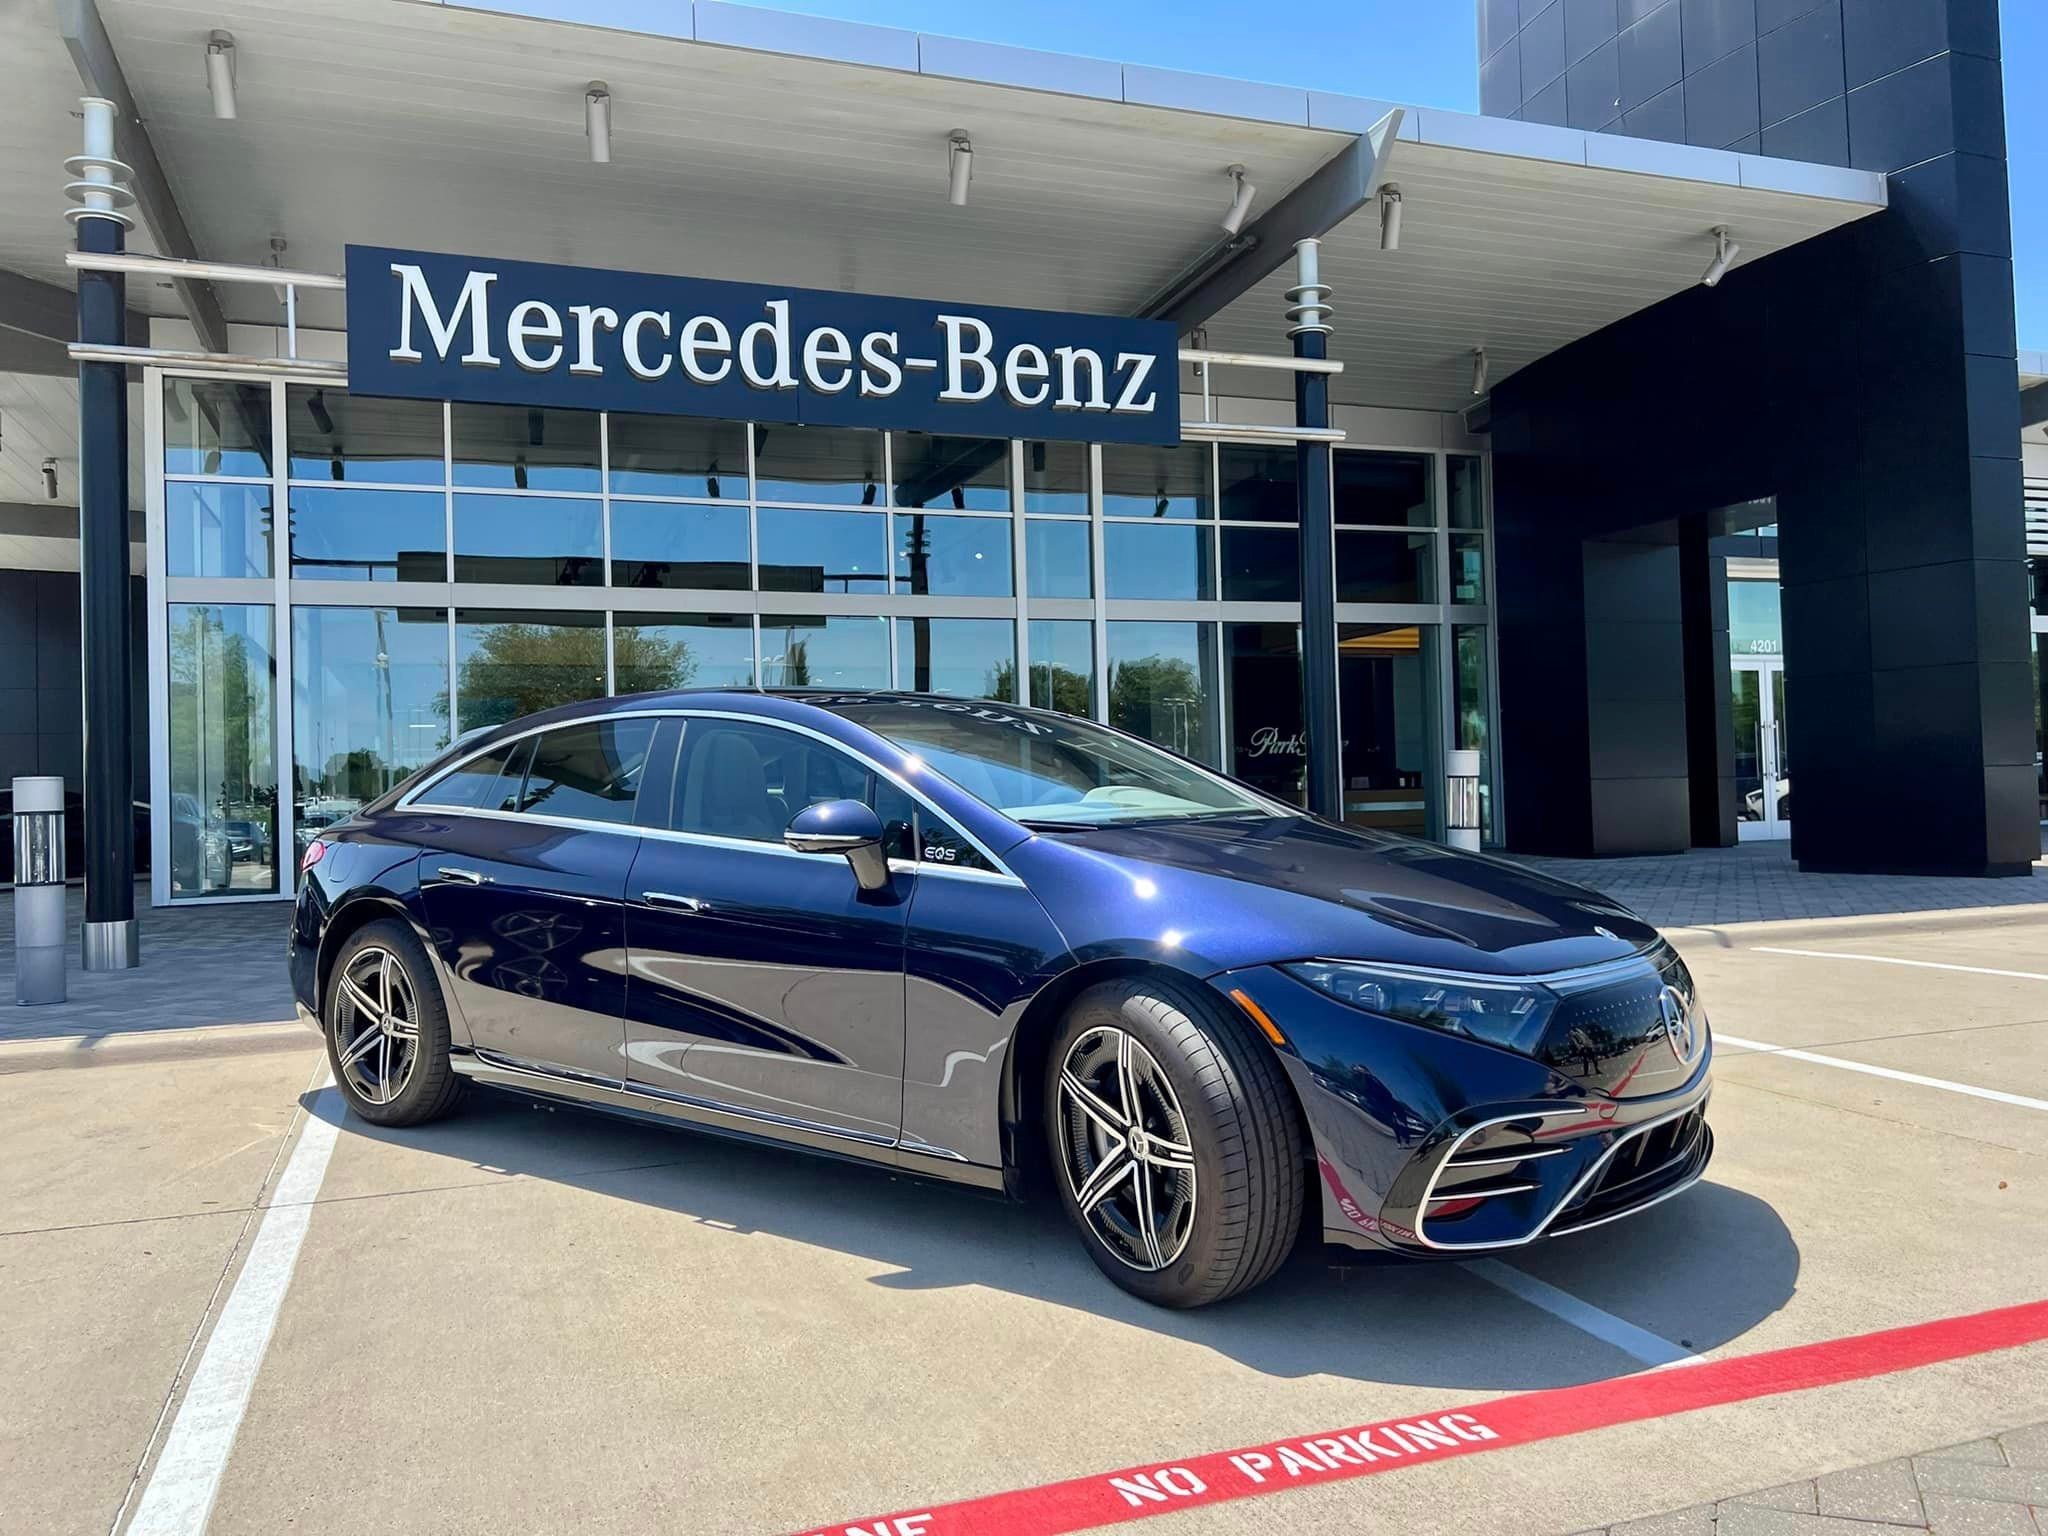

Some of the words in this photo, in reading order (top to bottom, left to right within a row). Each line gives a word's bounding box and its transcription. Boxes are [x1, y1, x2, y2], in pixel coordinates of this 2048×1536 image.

[389, 263, 1158, 414] Mercedes-Benz
[1750, 640, 1777, 653] 4201
[924, 846, 956, 861] EQS
[1108, 1466, 1208, 1507] NO
[1228, 1413, 1500, 1483] PARKING
